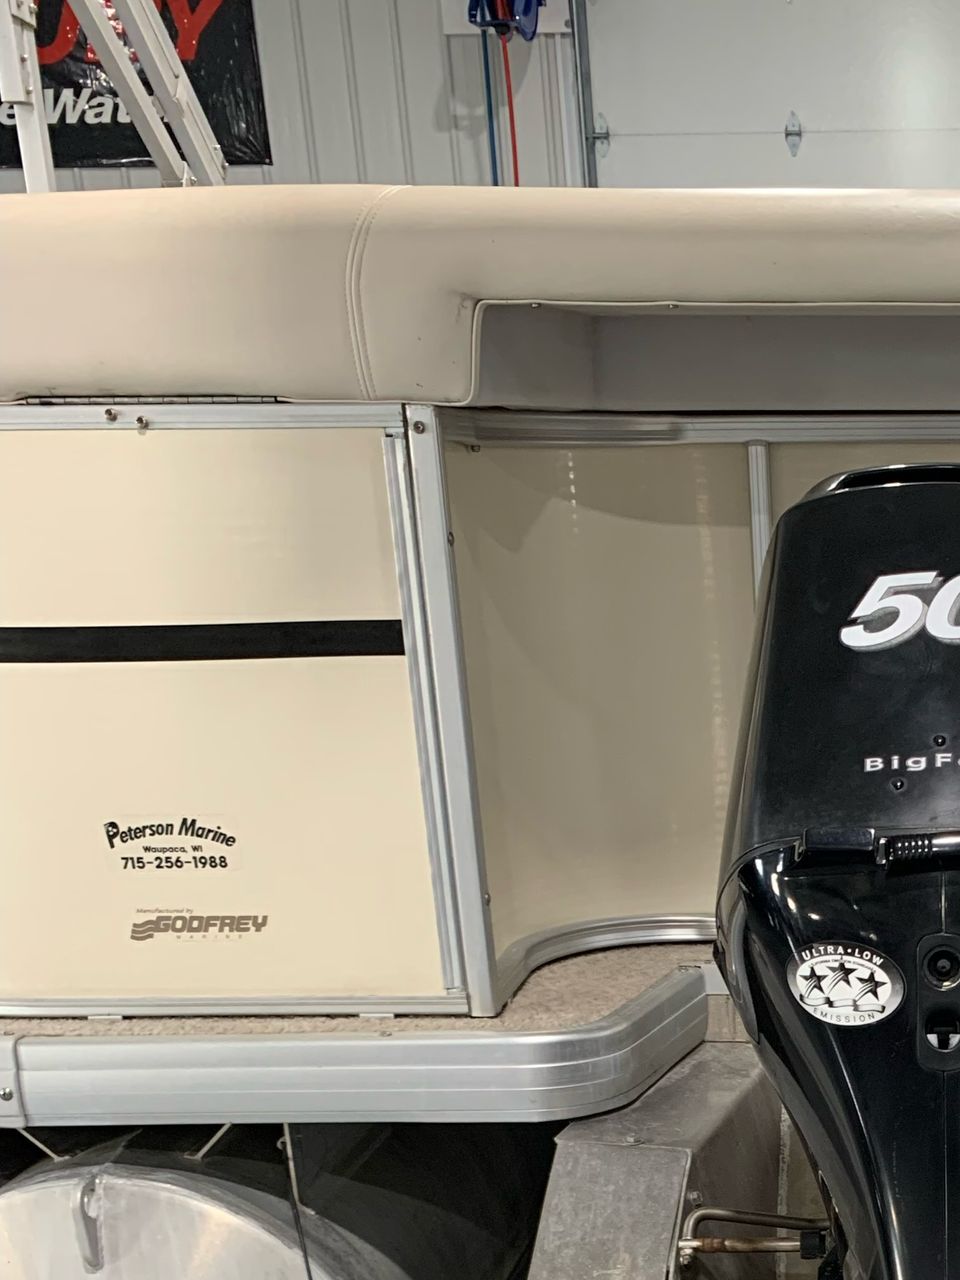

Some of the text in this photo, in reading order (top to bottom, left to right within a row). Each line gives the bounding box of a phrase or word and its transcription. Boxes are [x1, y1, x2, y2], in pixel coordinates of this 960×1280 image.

[104, 817, 236, 849] Peterson Marine
[142, 845, 188, 854] Waupaca,
[121, 856, 228, 869] 715-256-1988
[155, 915, 268, 933] GODFREY
[813, 1007, 876, 1023] EMISSION
